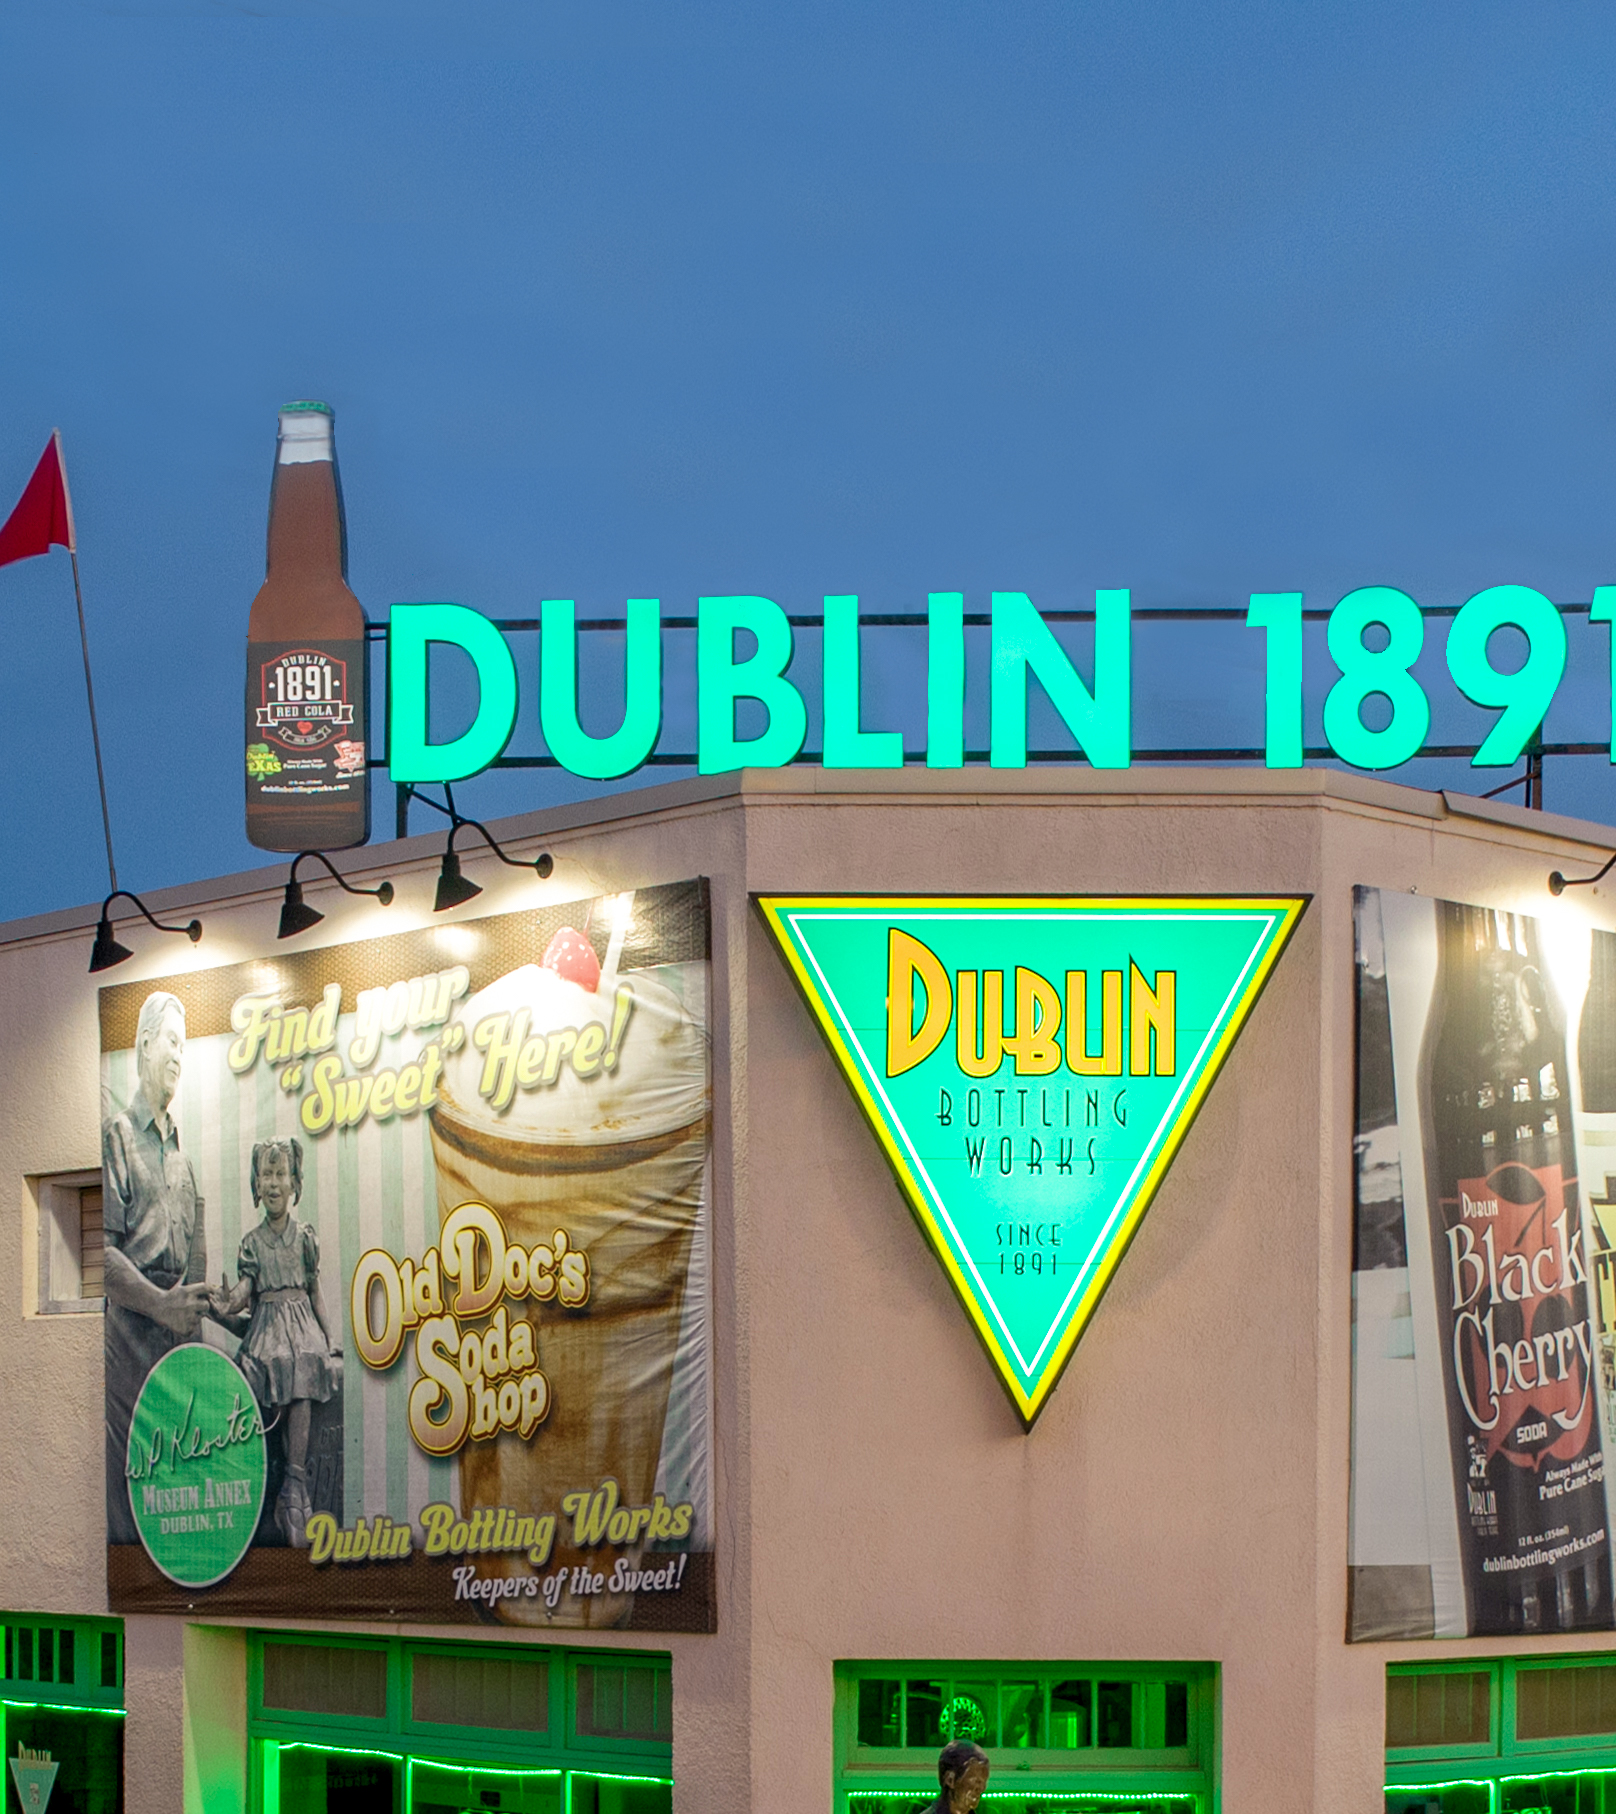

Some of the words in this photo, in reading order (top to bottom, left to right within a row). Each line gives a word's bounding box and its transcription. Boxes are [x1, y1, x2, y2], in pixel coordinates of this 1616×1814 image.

[281, 654, 327, 667] DUBLIN
[275, 665, 332, 701] 1891
[389, 589, 1131, 781] DUBLIN
[276, 706, 299, 717] RED
[304, 705, 333, 717] COLA
[248, 760, 283, 772] EXAS
[228, 983, 341, 1072] Find
[349, 965, 470, 1068] your
[886, 927, 1176, 1078] DUBLIN
[474, 982, 635, 1111] Here!
[938, 1089, 1127, 1128] BOTTLING
[966, 1137, 1097, 1177] WORKS
[1461, 1192, 1499, 1219] DUBLIN
[996, 1223, 1063, 1247] SINCE
[1000, 1253, 1058, 1276] 1891
[1445, 1208, 1588, 1311] Black
[351, 1247, 446, 1370] Old
[440, 1200, 590, 1320] Doc's
[1453, 1305, 1593, 1431] Cherry
[171, 1388, 281, 1472] Kloster
[1516, 1422, 1548, 1444] SODA
[1539, 1482, 1563, 1500] Pure
[1564, 1476, 1587, 1492] Cane
[1545, 1466, 1571, 1482] Always
[1571, 1458, 1589, 1473] Made
[142, 1484, 199, 1515] MUSEUM
[204, 1478, 251, 1508] ANNEX
[160, 1513, 214, 1535] DUBLIN,
[216, 1511, 234, 1529] TX
[306, 1512, 412, 1564] Dublin
[420, 1504, 556, 1566] Bottling
[562, 1477, 694, 1546] Works
[1483, 1529, 1605, 1572] dublinbottlingworks.com
[1518, 1538, 1526, 1546] 12
[452, 1566, 538, 1607] Keepers
[542, 1566, 567, 1608] of
[570, 1567, 604, 1596] the
[608, 1553, 687, 1594] Sweet!
